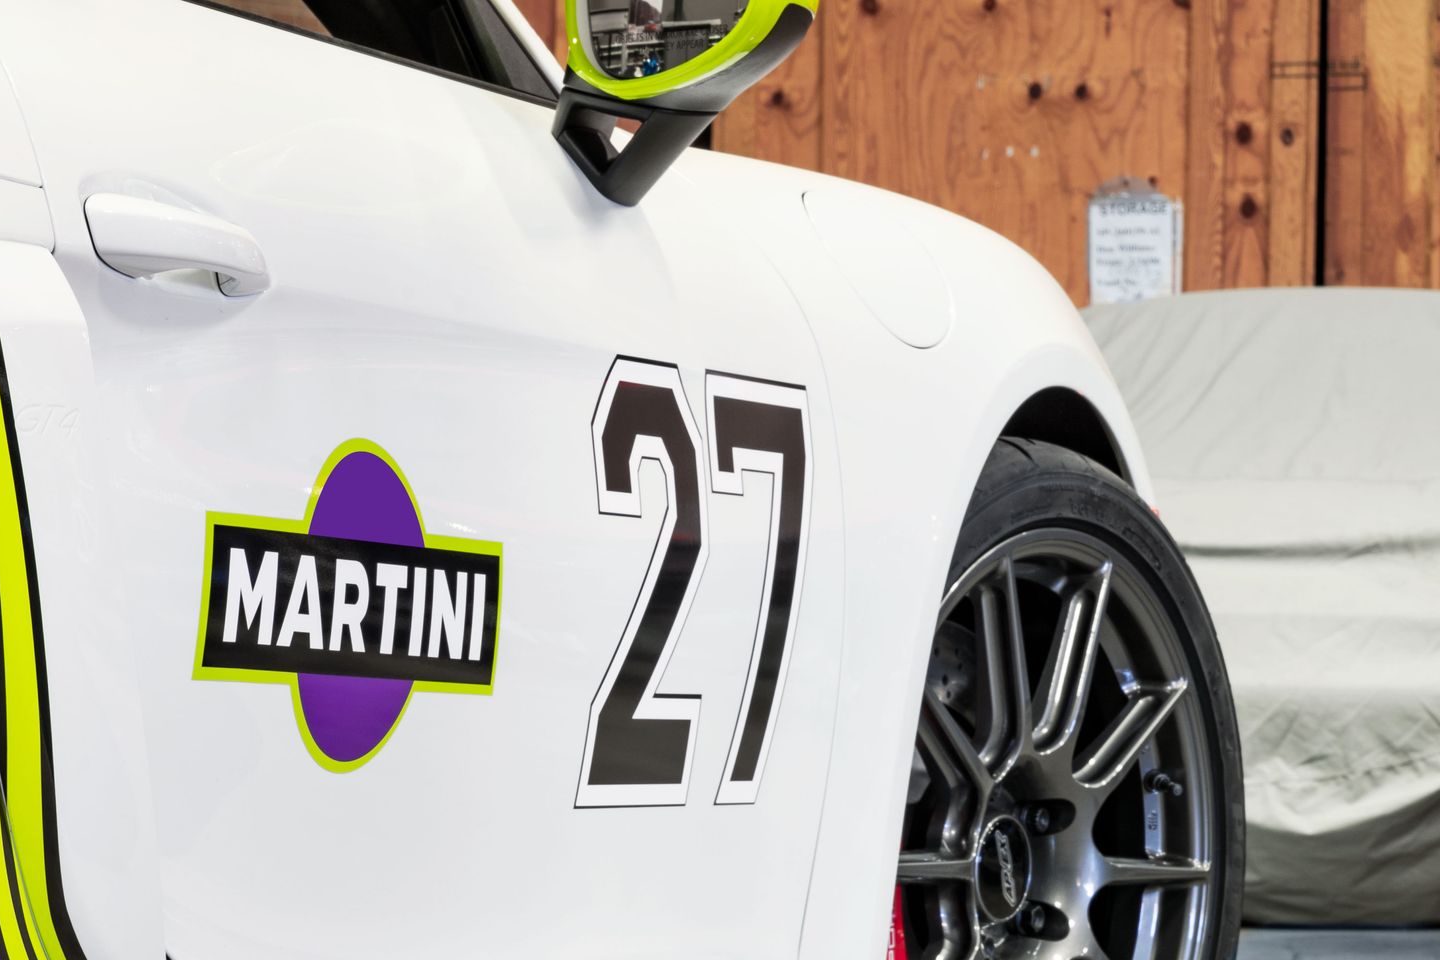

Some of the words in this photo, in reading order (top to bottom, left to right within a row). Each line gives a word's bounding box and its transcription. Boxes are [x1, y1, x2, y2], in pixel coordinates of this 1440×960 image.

[14, 402, 81, 438] GT4
[222, 547, 487, 661] MARTINI
[573, 354, 814, 809] 27
